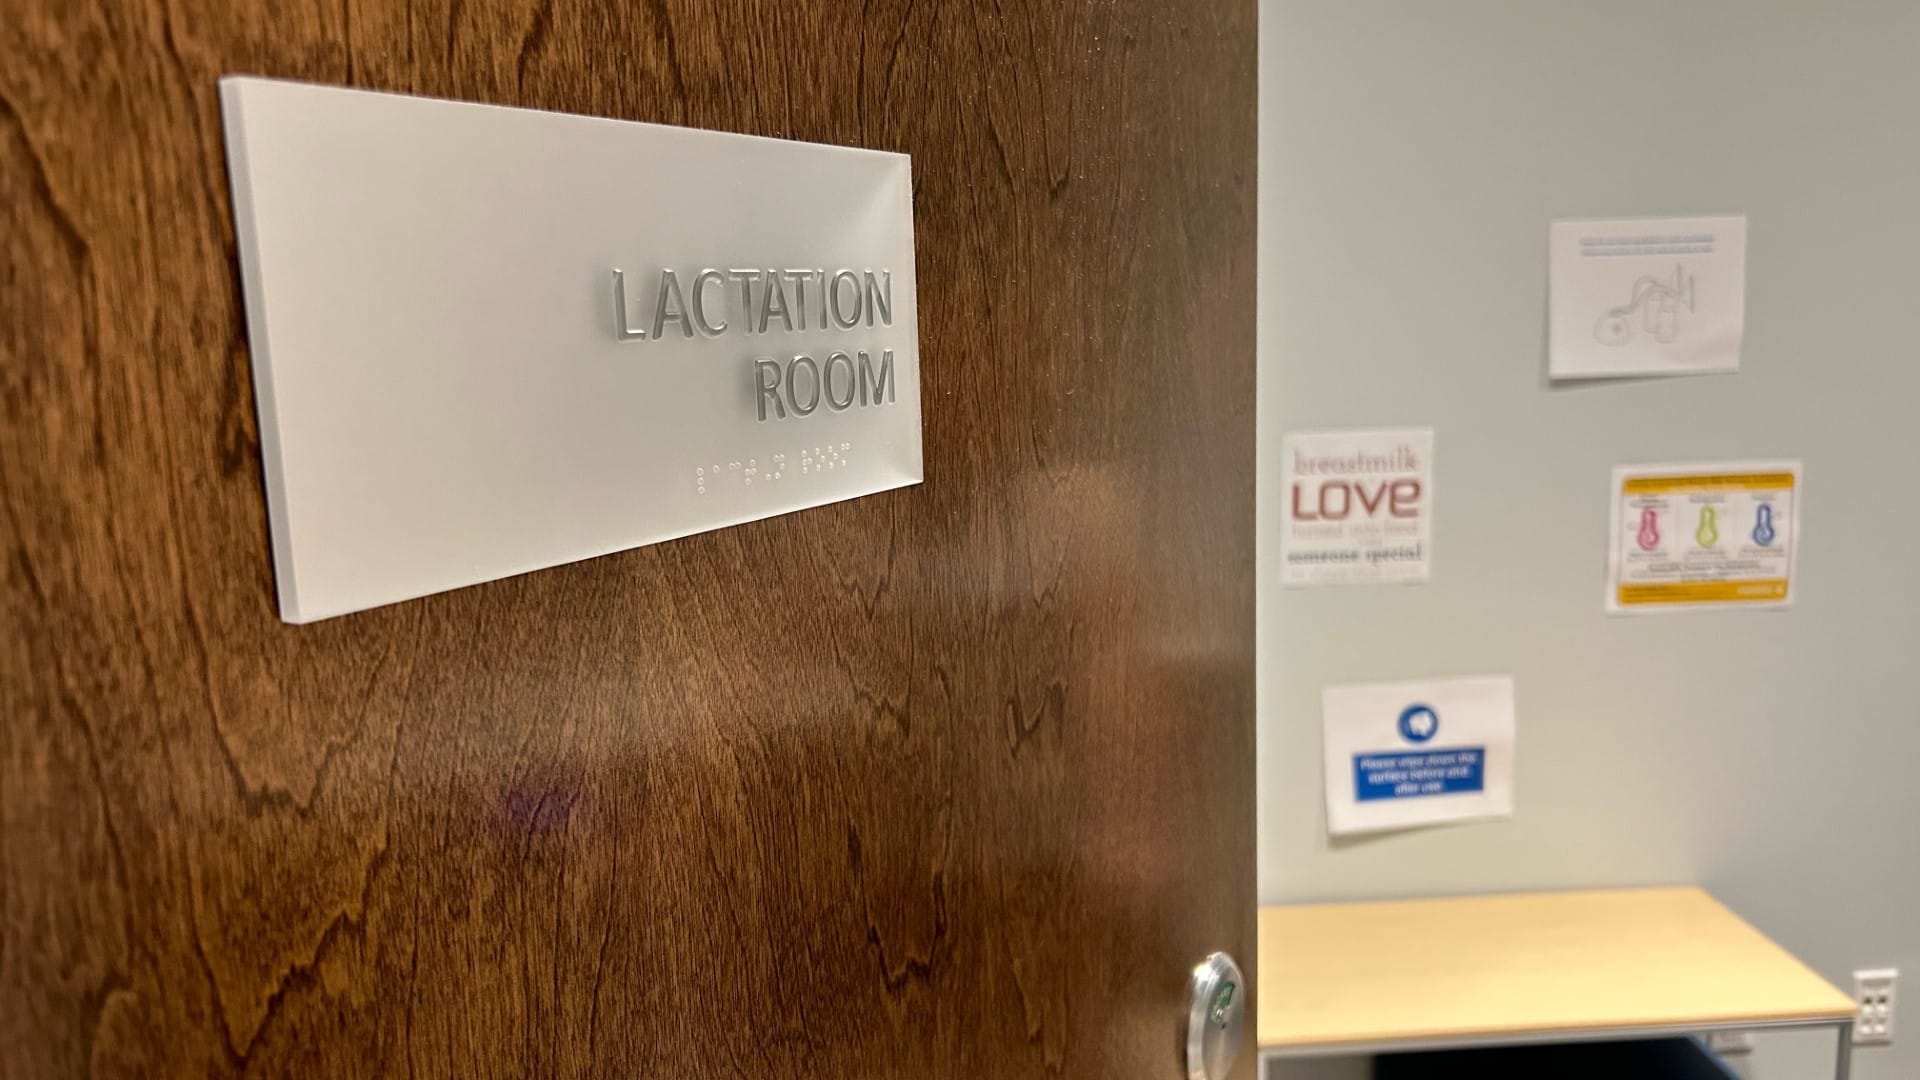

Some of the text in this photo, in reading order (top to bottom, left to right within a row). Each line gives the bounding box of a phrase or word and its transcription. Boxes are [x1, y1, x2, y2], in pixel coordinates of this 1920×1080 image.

[611, 268, 893, 342] LACTATION
[754, 349, 896, 422] ROOM
[1294, 445, 1416, 476] breastmilk
[1287, 543, 1422, 567] someone special
[1360, 755, 1397, 770] Please
